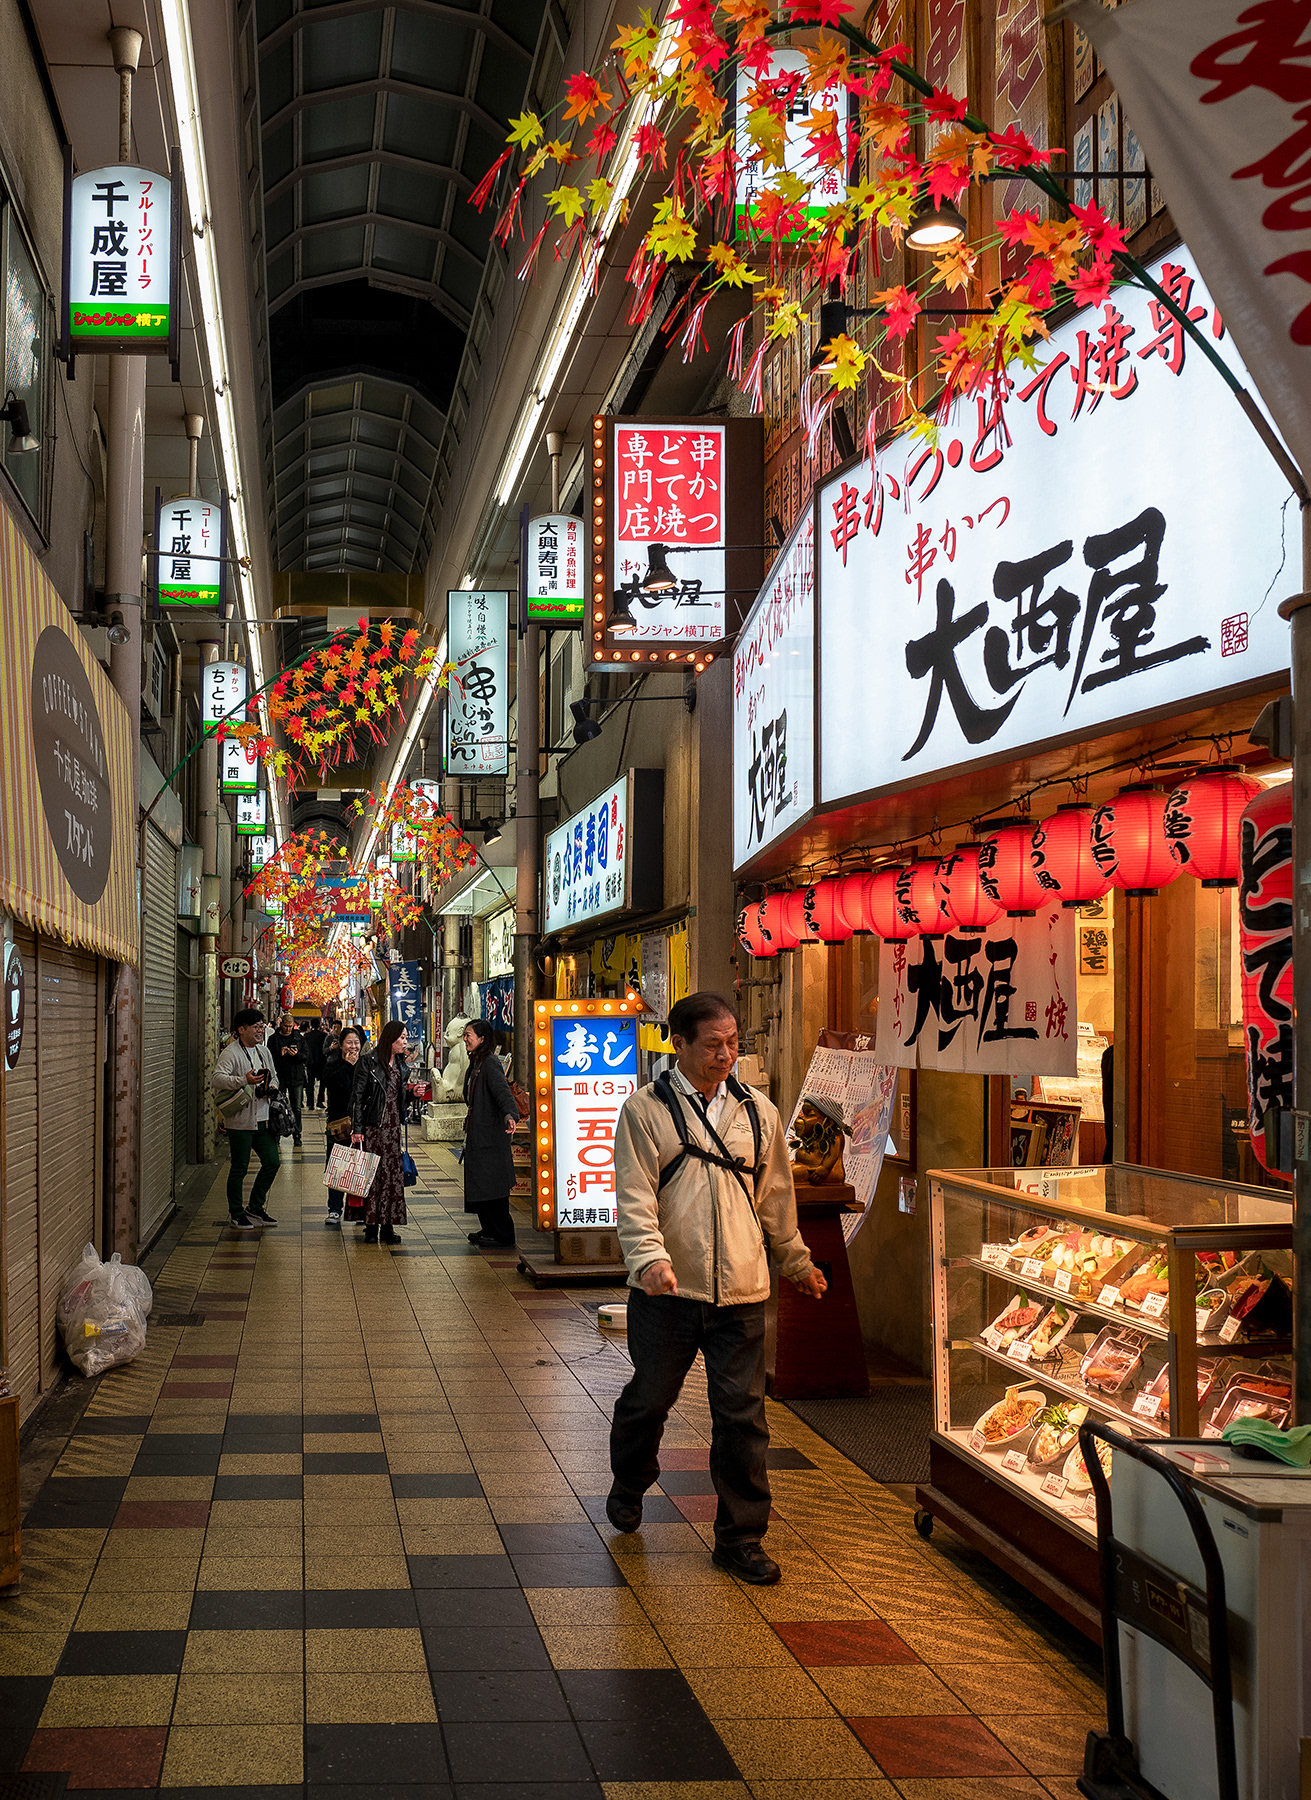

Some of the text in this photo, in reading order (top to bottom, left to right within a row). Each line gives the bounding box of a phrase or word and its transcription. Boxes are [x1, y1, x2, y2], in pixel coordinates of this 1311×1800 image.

[90, 181, 129, 297] 千成屋
[137, 180, 153, 289] フルーツパーラ
[73, 312, 167, 327] ジャンジャン横丁
[829, 262, 1225, 567] 串かつ・どて焼専
[618, 432, 653, 540] 専門店
[653, 434, 687, 538] どて焼
[687, 433, 718, 533] 串かつ
[170, 509, 192, 580] 千成屋
[201, 507, 211, 549] コーヒー
[905, 497, 1010, 602] 串かつ
[161, 589, 218, 599] ジャンジャン横丁
[474, 594, 489, 636] 味自慢
[529, 602, 584, 613] ジャンジャン横丁
[901, 506, 1211, 761] 大西屋
[43, 673, 72, 718] COFFEE
[210, 669, 226, 718] ちとせ
[227, 744, 240, 779] 大西
[748, 707, 794, 852] 大西屋
[64, 808, 95, 867] スタンド
[1090, 805, 1119, 878] ホルモン
[1164, 788, 1192, 864] お造り
[223, 962, 248, 973] たばこ
[903, 934, 1039, 1056] 大西屋
[557, 1022, 633, 1073] 寿し
[566, 1173, 577, 1200] より
